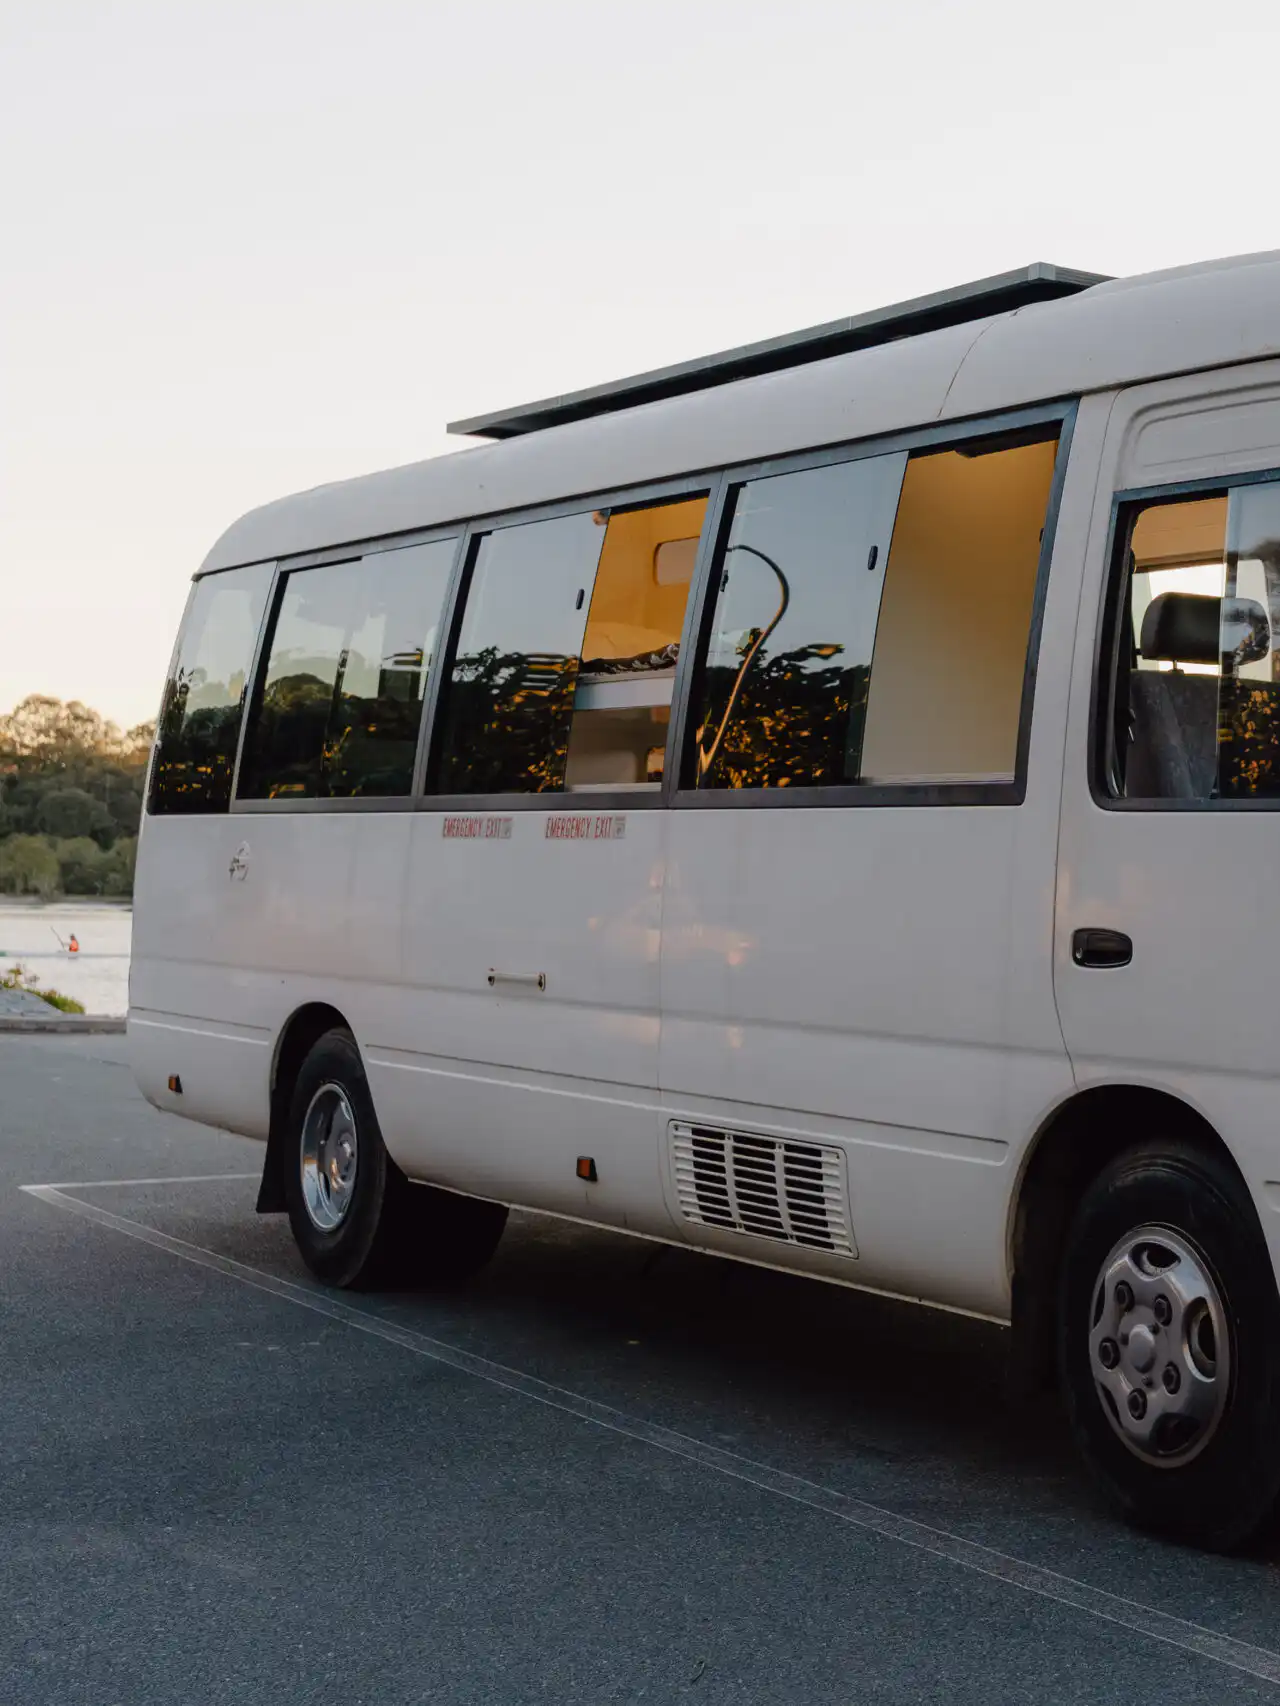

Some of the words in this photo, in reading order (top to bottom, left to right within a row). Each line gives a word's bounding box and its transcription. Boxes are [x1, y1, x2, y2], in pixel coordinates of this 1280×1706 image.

[443, 817, 483, 838] EMERGENCY
[485, 817, 502, 838] EXIT
[545, 817, 592, 839] EMERGENCY
[593, 816, 613, 839] EXIT
